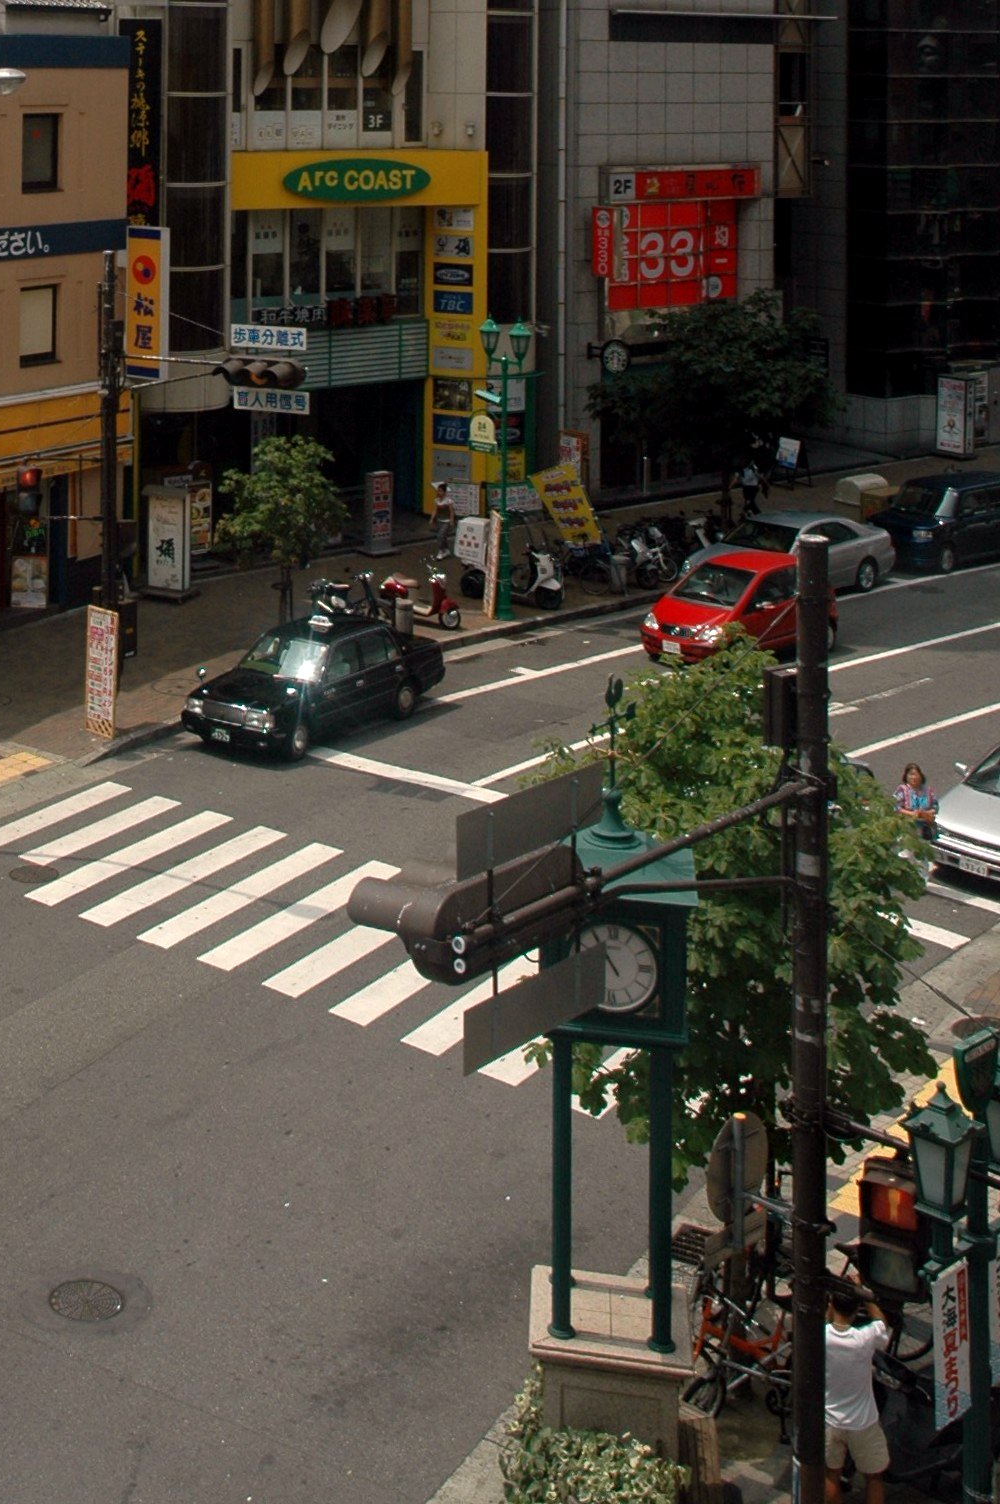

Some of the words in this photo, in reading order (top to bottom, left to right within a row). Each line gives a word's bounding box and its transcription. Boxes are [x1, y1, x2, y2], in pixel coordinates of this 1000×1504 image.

[367, 114, 385, 129] 3F
[297, 169, 339, 193] Arc
[343, 168, 417, 192] COAST
[613, 179, 632, 195] 2F
[439, 299, 467, 312] TBC
[132, 291, 155, 350] 松屋
[233, 328, 305, 348] 歩車分離式
[436, 425, 467, 442] TBC
